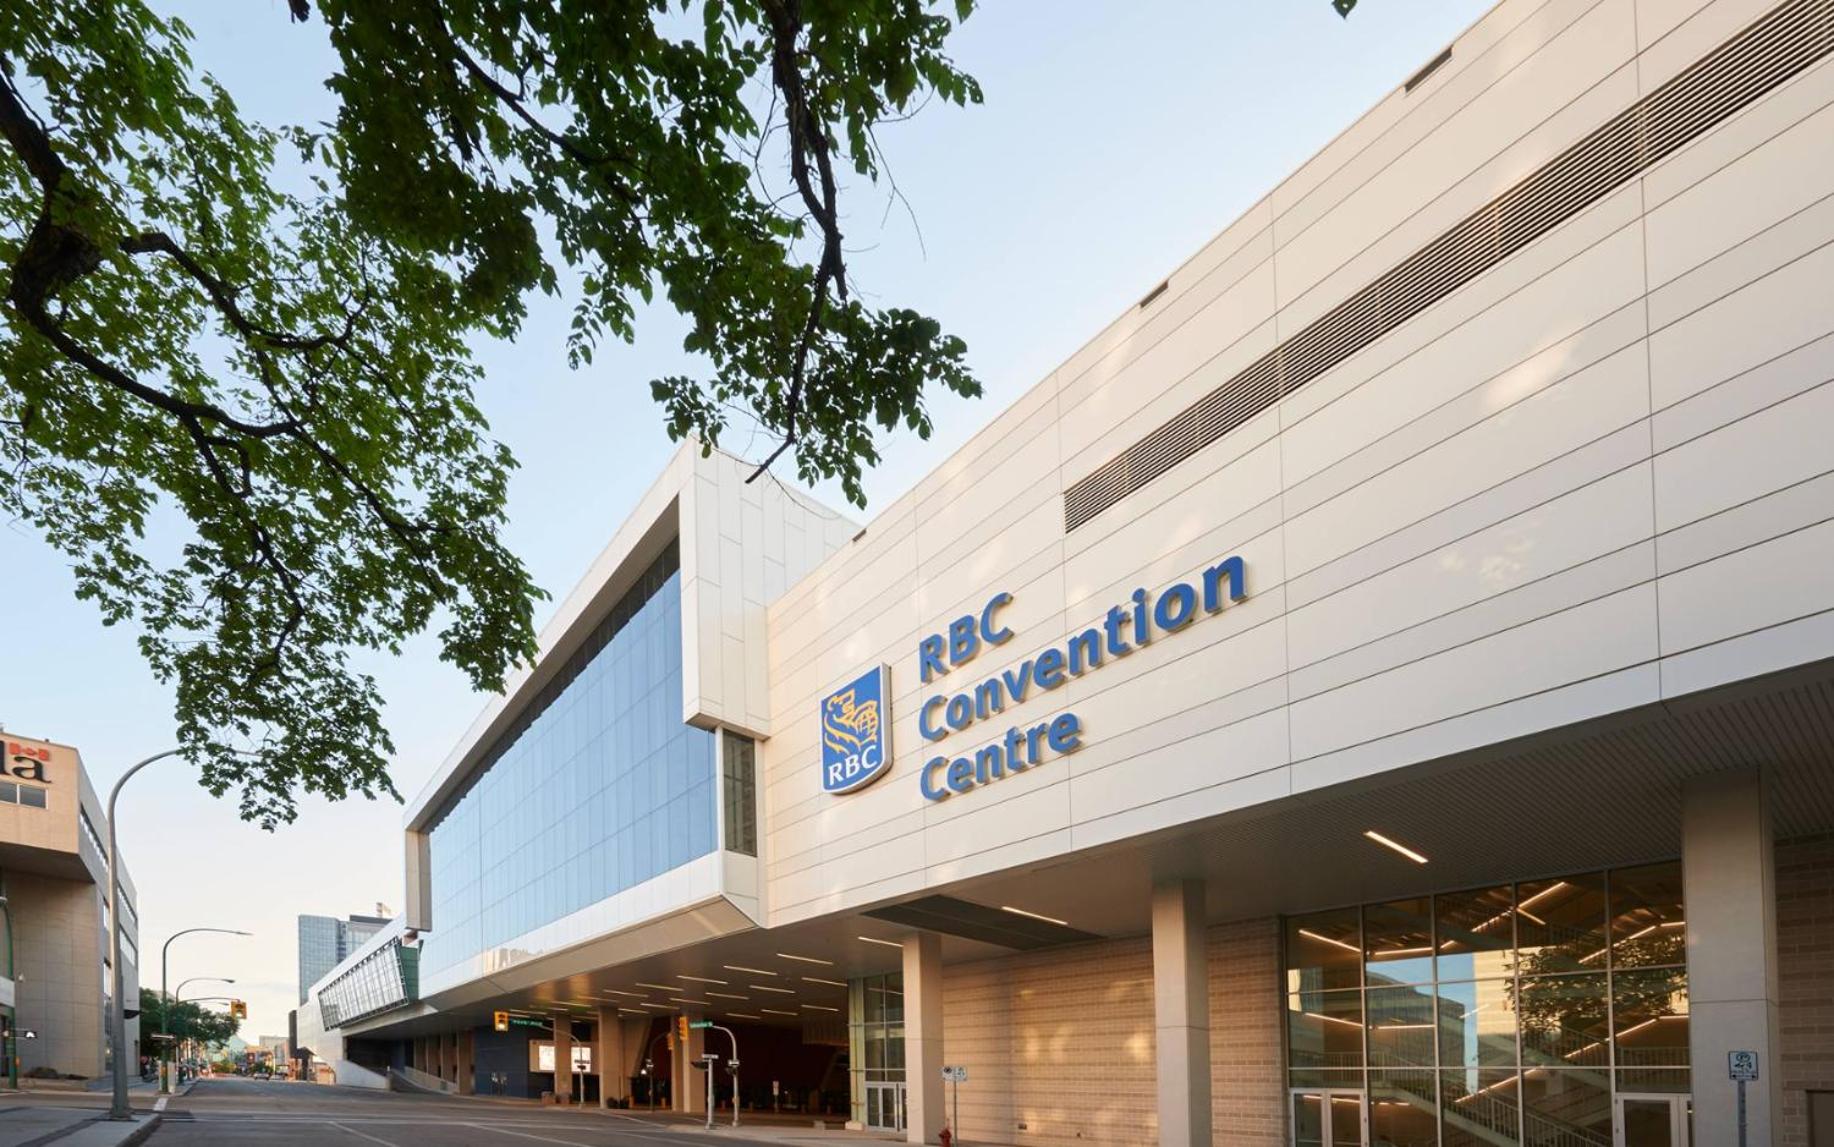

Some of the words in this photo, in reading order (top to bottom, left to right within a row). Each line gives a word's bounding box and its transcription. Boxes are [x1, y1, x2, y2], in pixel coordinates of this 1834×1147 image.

[918, 555, 1246, 741] Convention
[919, 592, 1014, 682] RBC
[828, 744, 878, 786] RBC
[919, 711, 1082, 801] Centre
